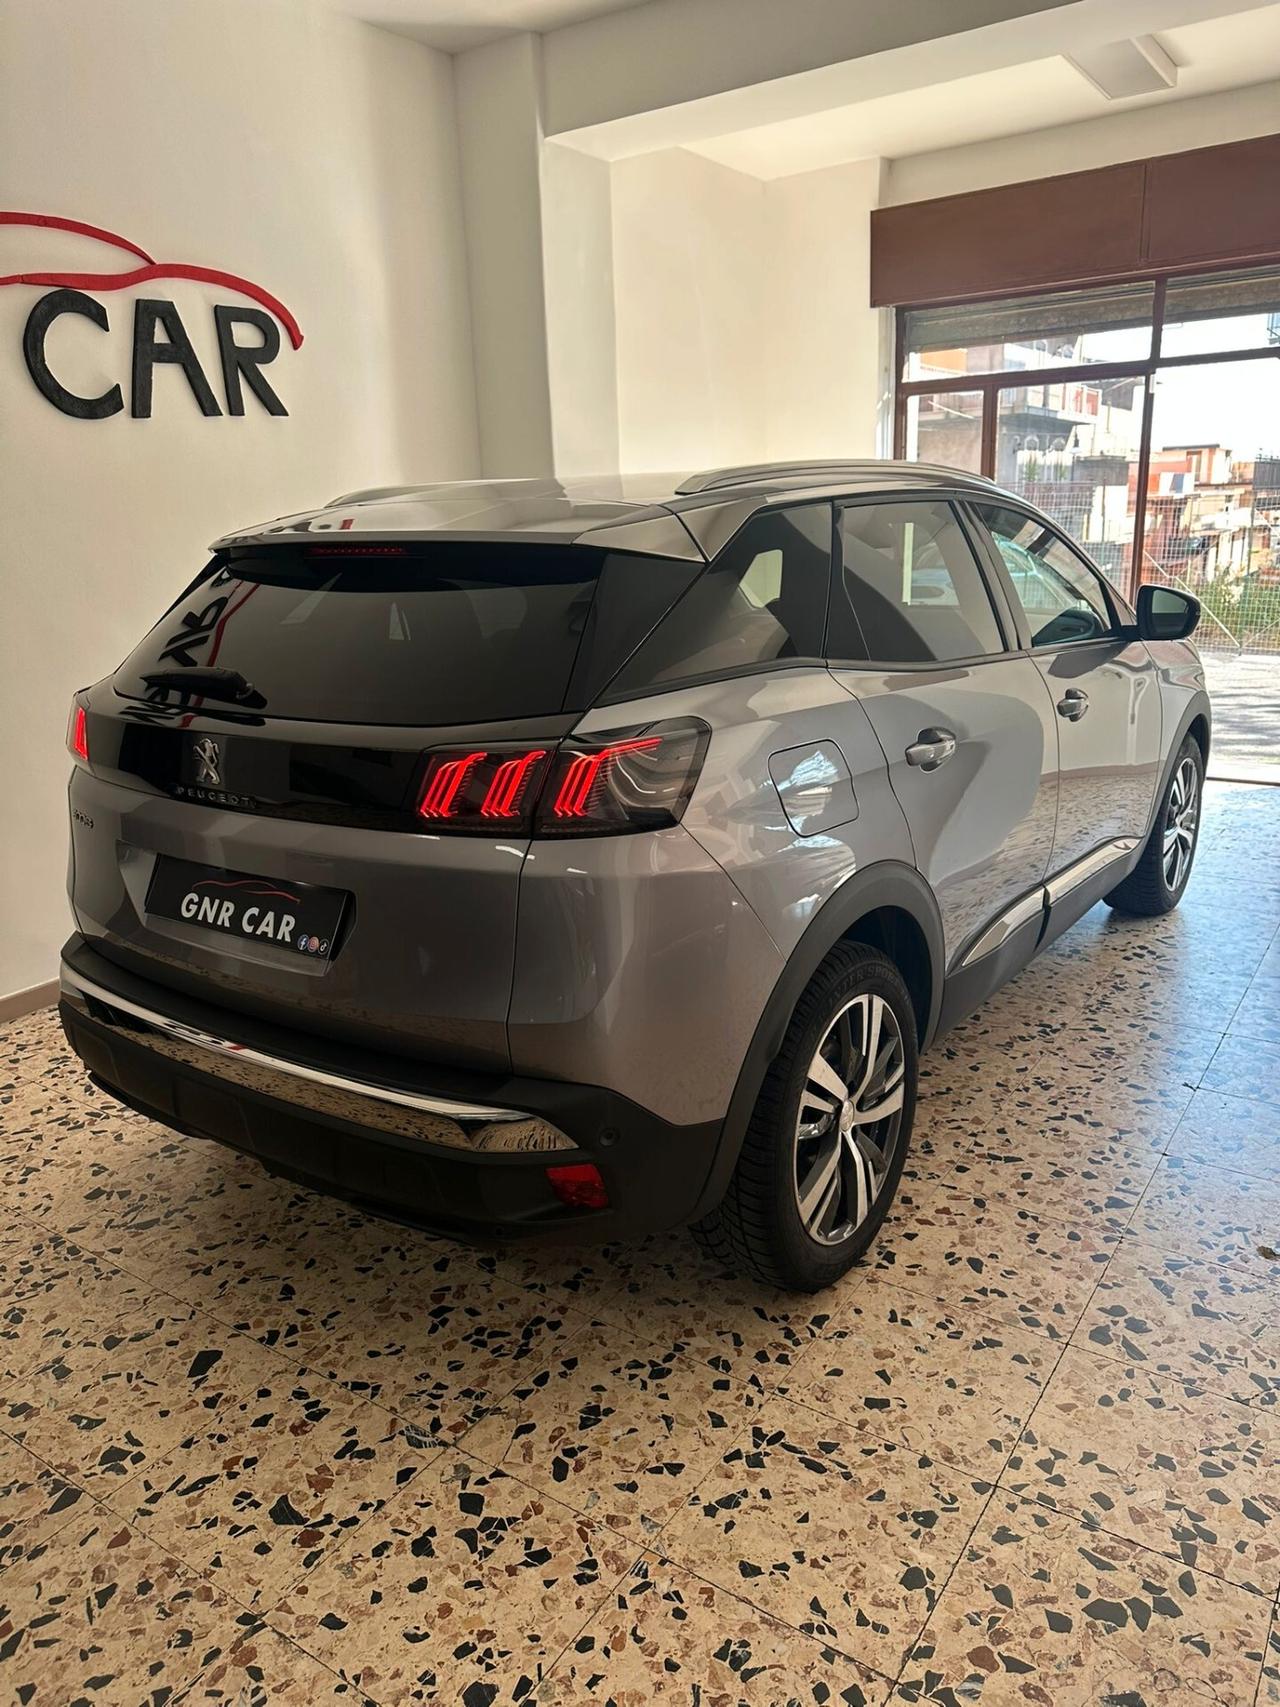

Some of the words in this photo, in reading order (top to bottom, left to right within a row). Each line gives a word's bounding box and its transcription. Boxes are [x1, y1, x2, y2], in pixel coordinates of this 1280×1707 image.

[23, 289, 289, 420] CAR
[180, 892, 235, 928] GNR
[241, 907, 296, 943] CAR
